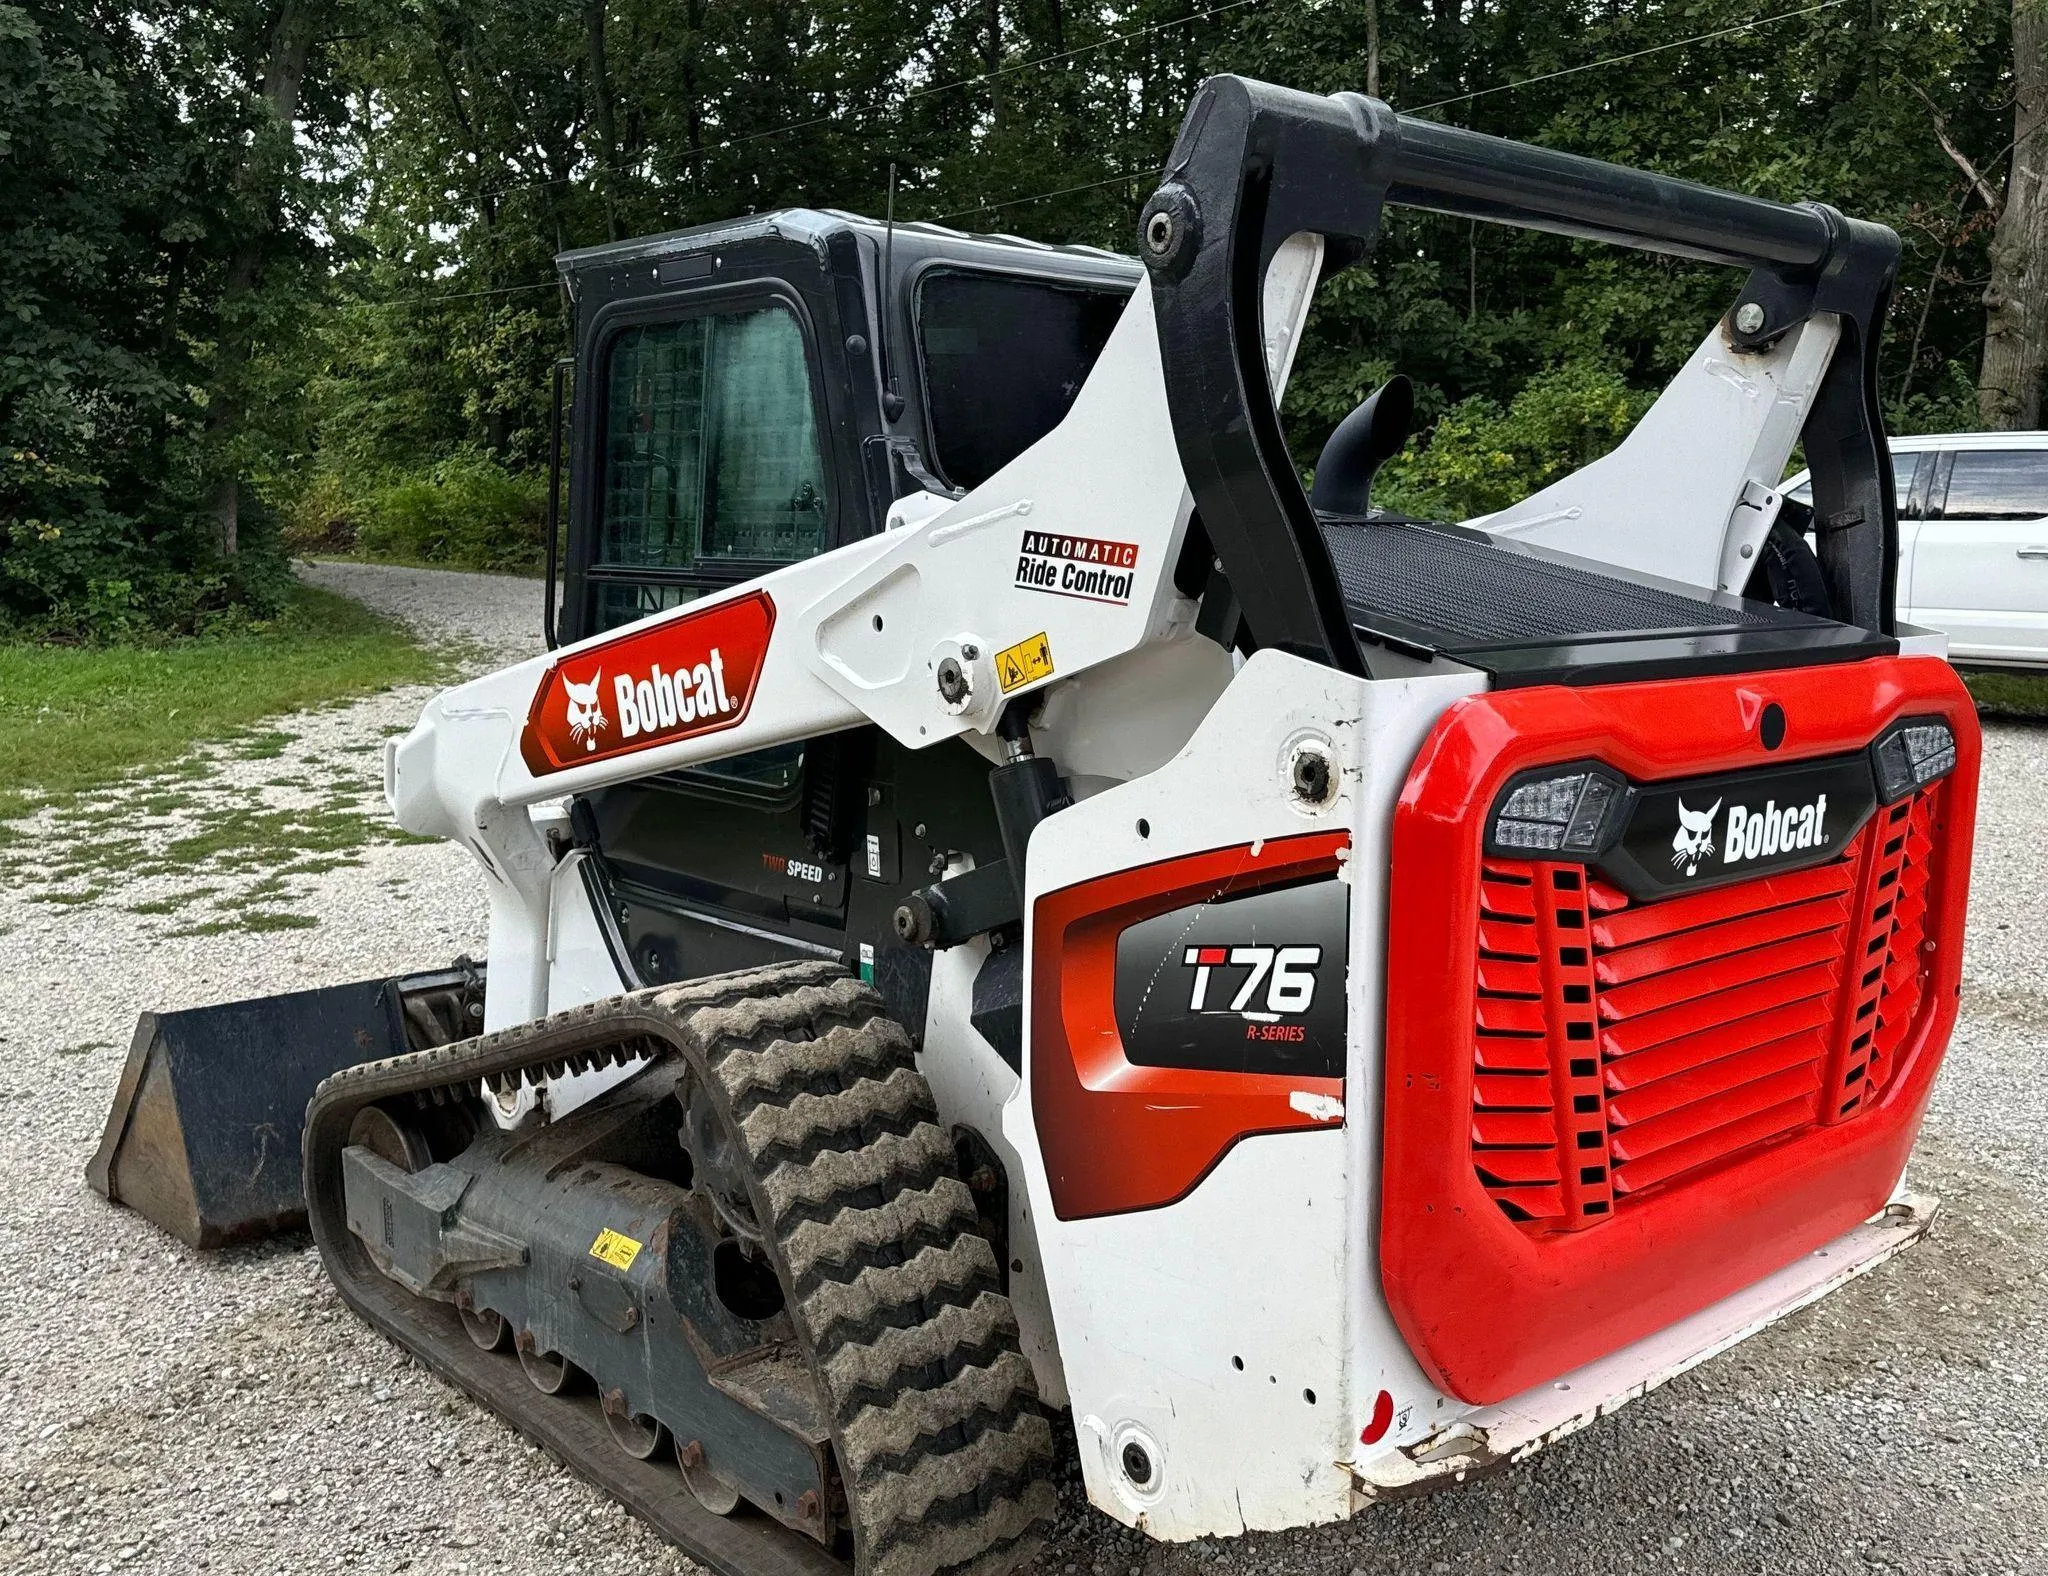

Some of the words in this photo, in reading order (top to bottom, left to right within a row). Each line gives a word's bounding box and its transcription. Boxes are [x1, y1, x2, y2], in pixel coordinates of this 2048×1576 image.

[1025, 535, 1133, 566] AUTOMATIC
[1015, 556, 1057, 587] Ride
[1061, 563, 1134, 599] Control
[613, 648, 731, 738] Bobcat
[1723, 793, 1827, 864] Bobcat
[762, 854, 786, 872] TWO
[787, 859, 823, 883] SPEED
[1184, 947, 1321, 1013] T76
[1246, 1024, 1306, 1043] R-SERIES
